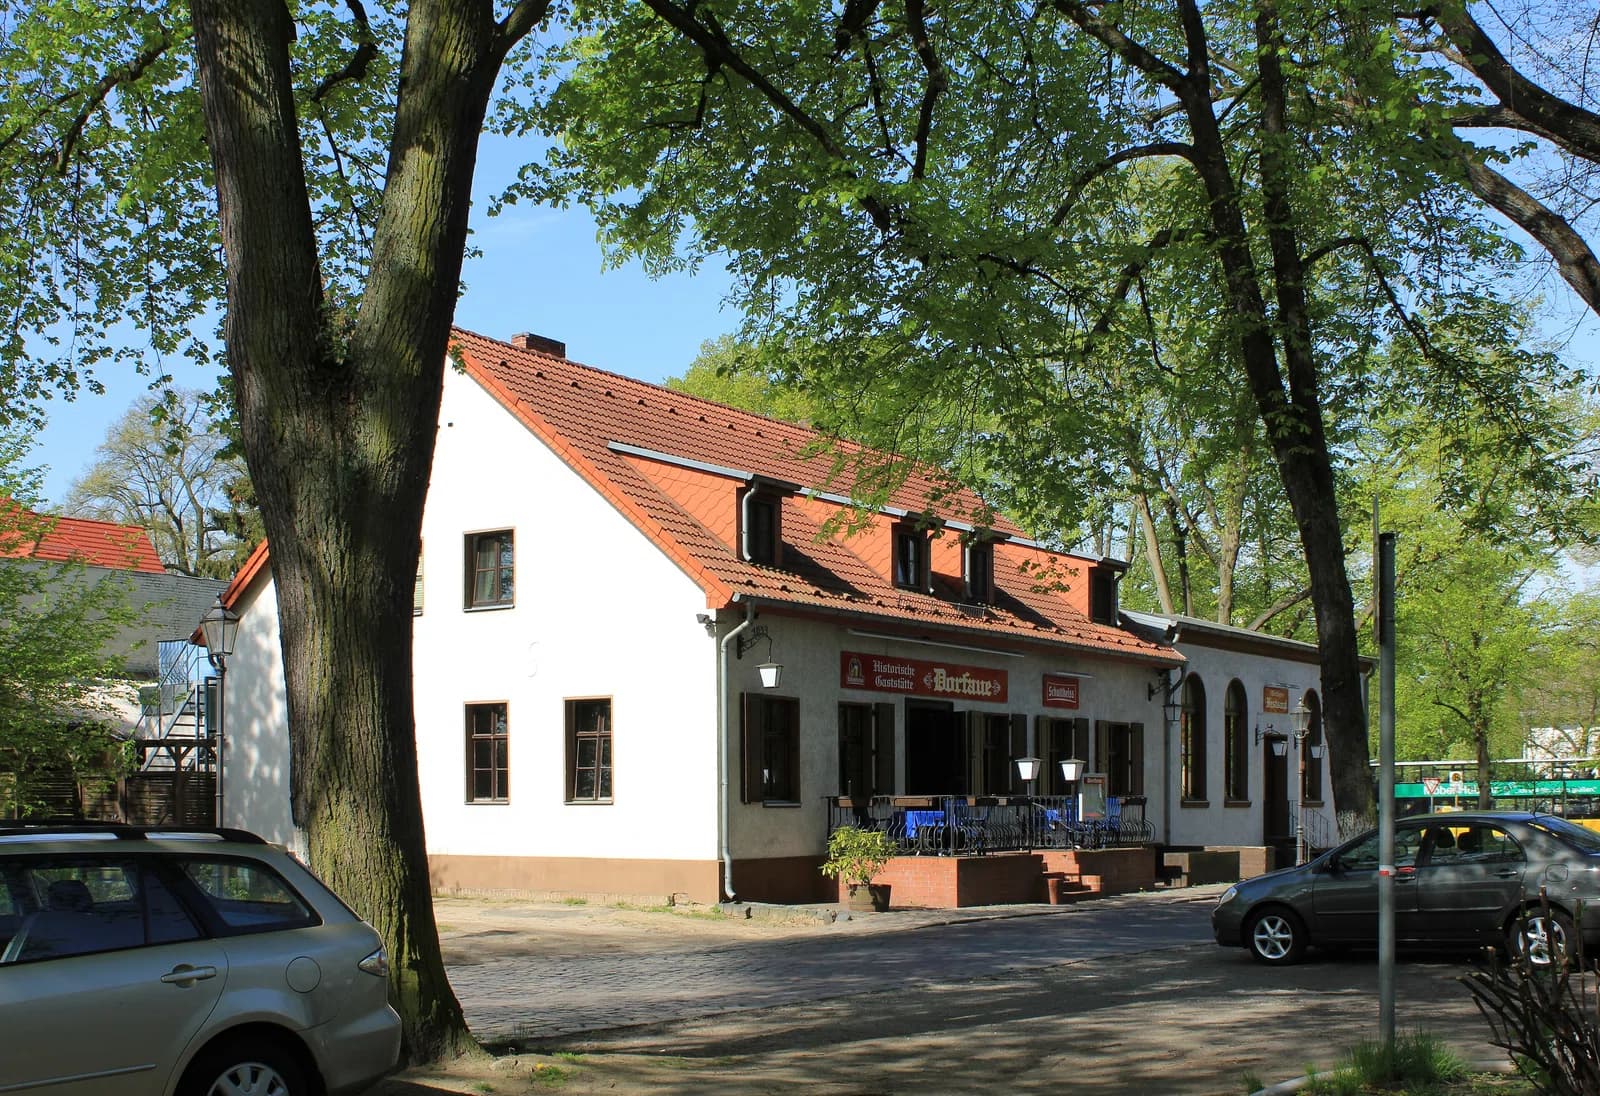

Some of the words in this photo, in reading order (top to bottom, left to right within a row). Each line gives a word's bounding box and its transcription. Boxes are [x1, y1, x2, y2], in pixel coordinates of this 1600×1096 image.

[872, 659, 915, 676] Historische
[875, 674, 914, 690] Gaststätte
[933, 667, 993, 697] Dorfaue
